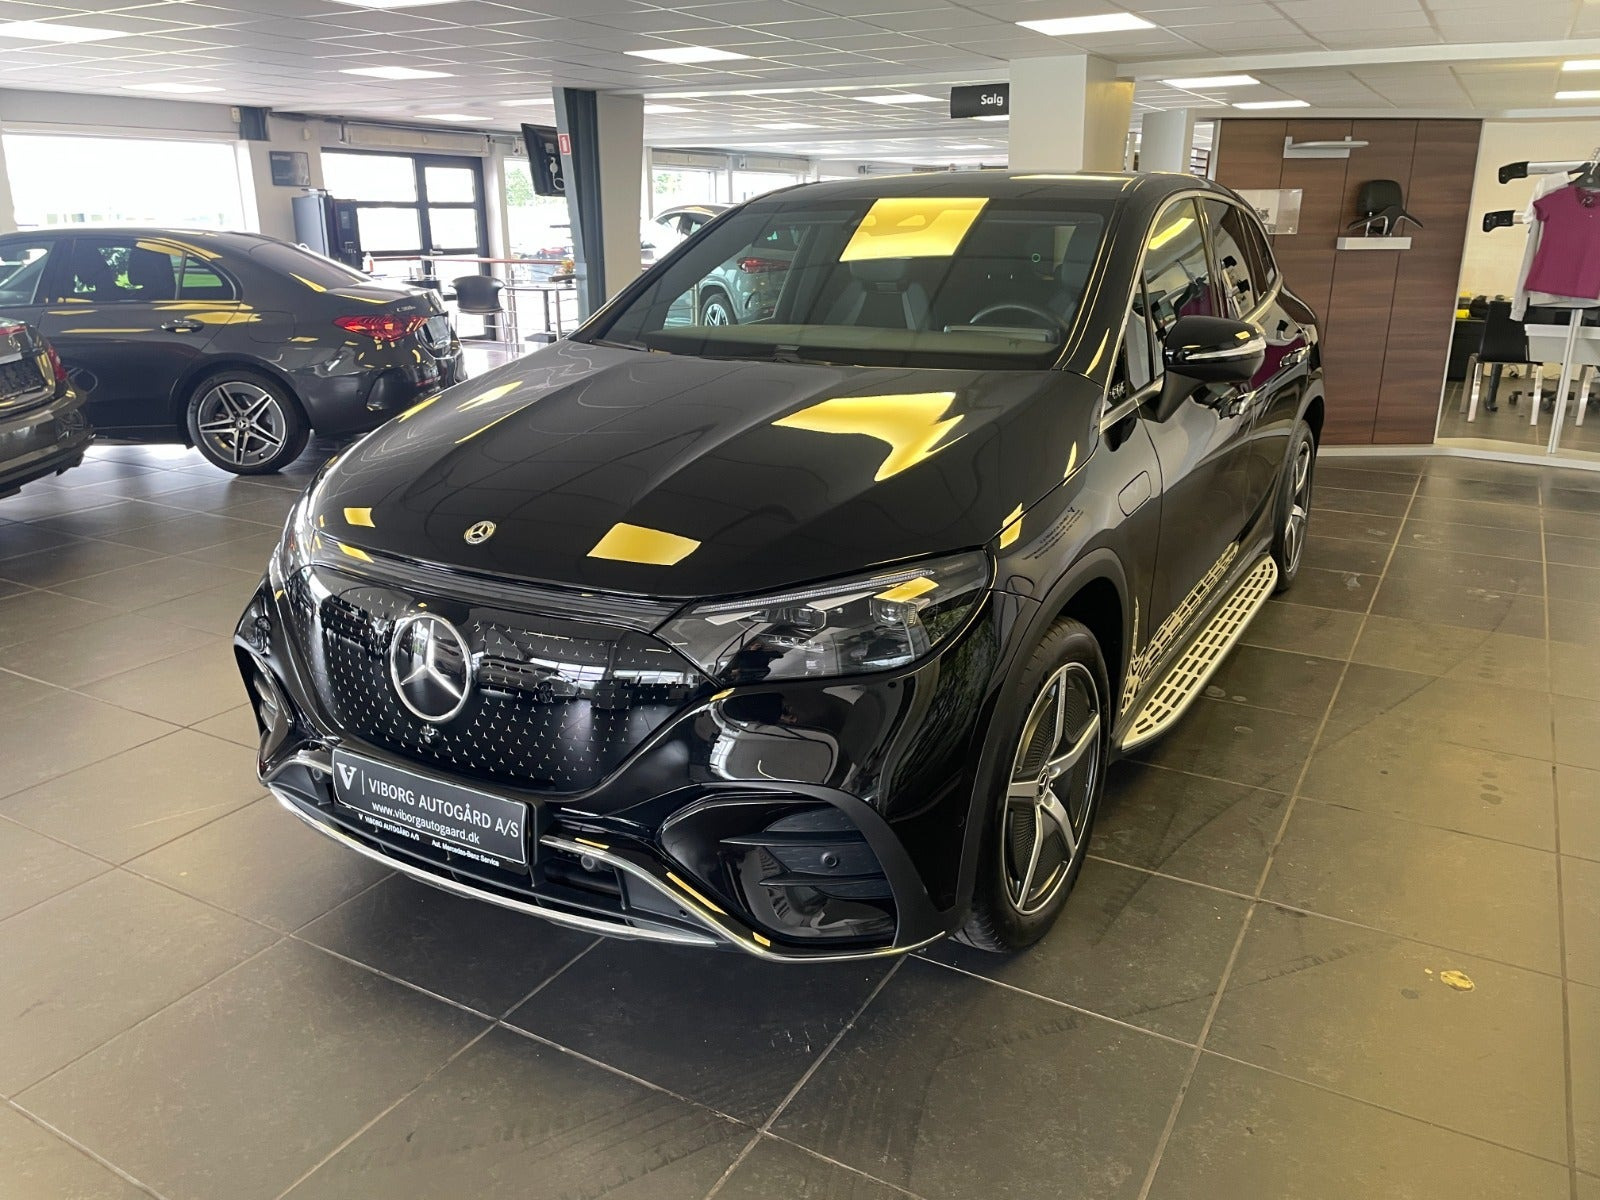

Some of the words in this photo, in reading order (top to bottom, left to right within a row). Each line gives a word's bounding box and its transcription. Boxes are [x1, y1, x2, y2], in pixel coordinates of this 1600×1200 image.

[980, 93, 1004, 106] Salg
[368, 777, 415, 806] VIBORG
[418, 794, 492, 829] AUTOGÅRD
[494, 817, 520, 839] A/S
[364, 815, 383, 829] VIBORG
[383, 822, 410, 838] AUTOGÅRD
[371, 801, 480, 845] www.viborgautogaard.dk
[431, 839, 442, 849] Aut.
[442, 842, 480, 861] Mercedes-Benz
[480, 854, 500, 867] Service
